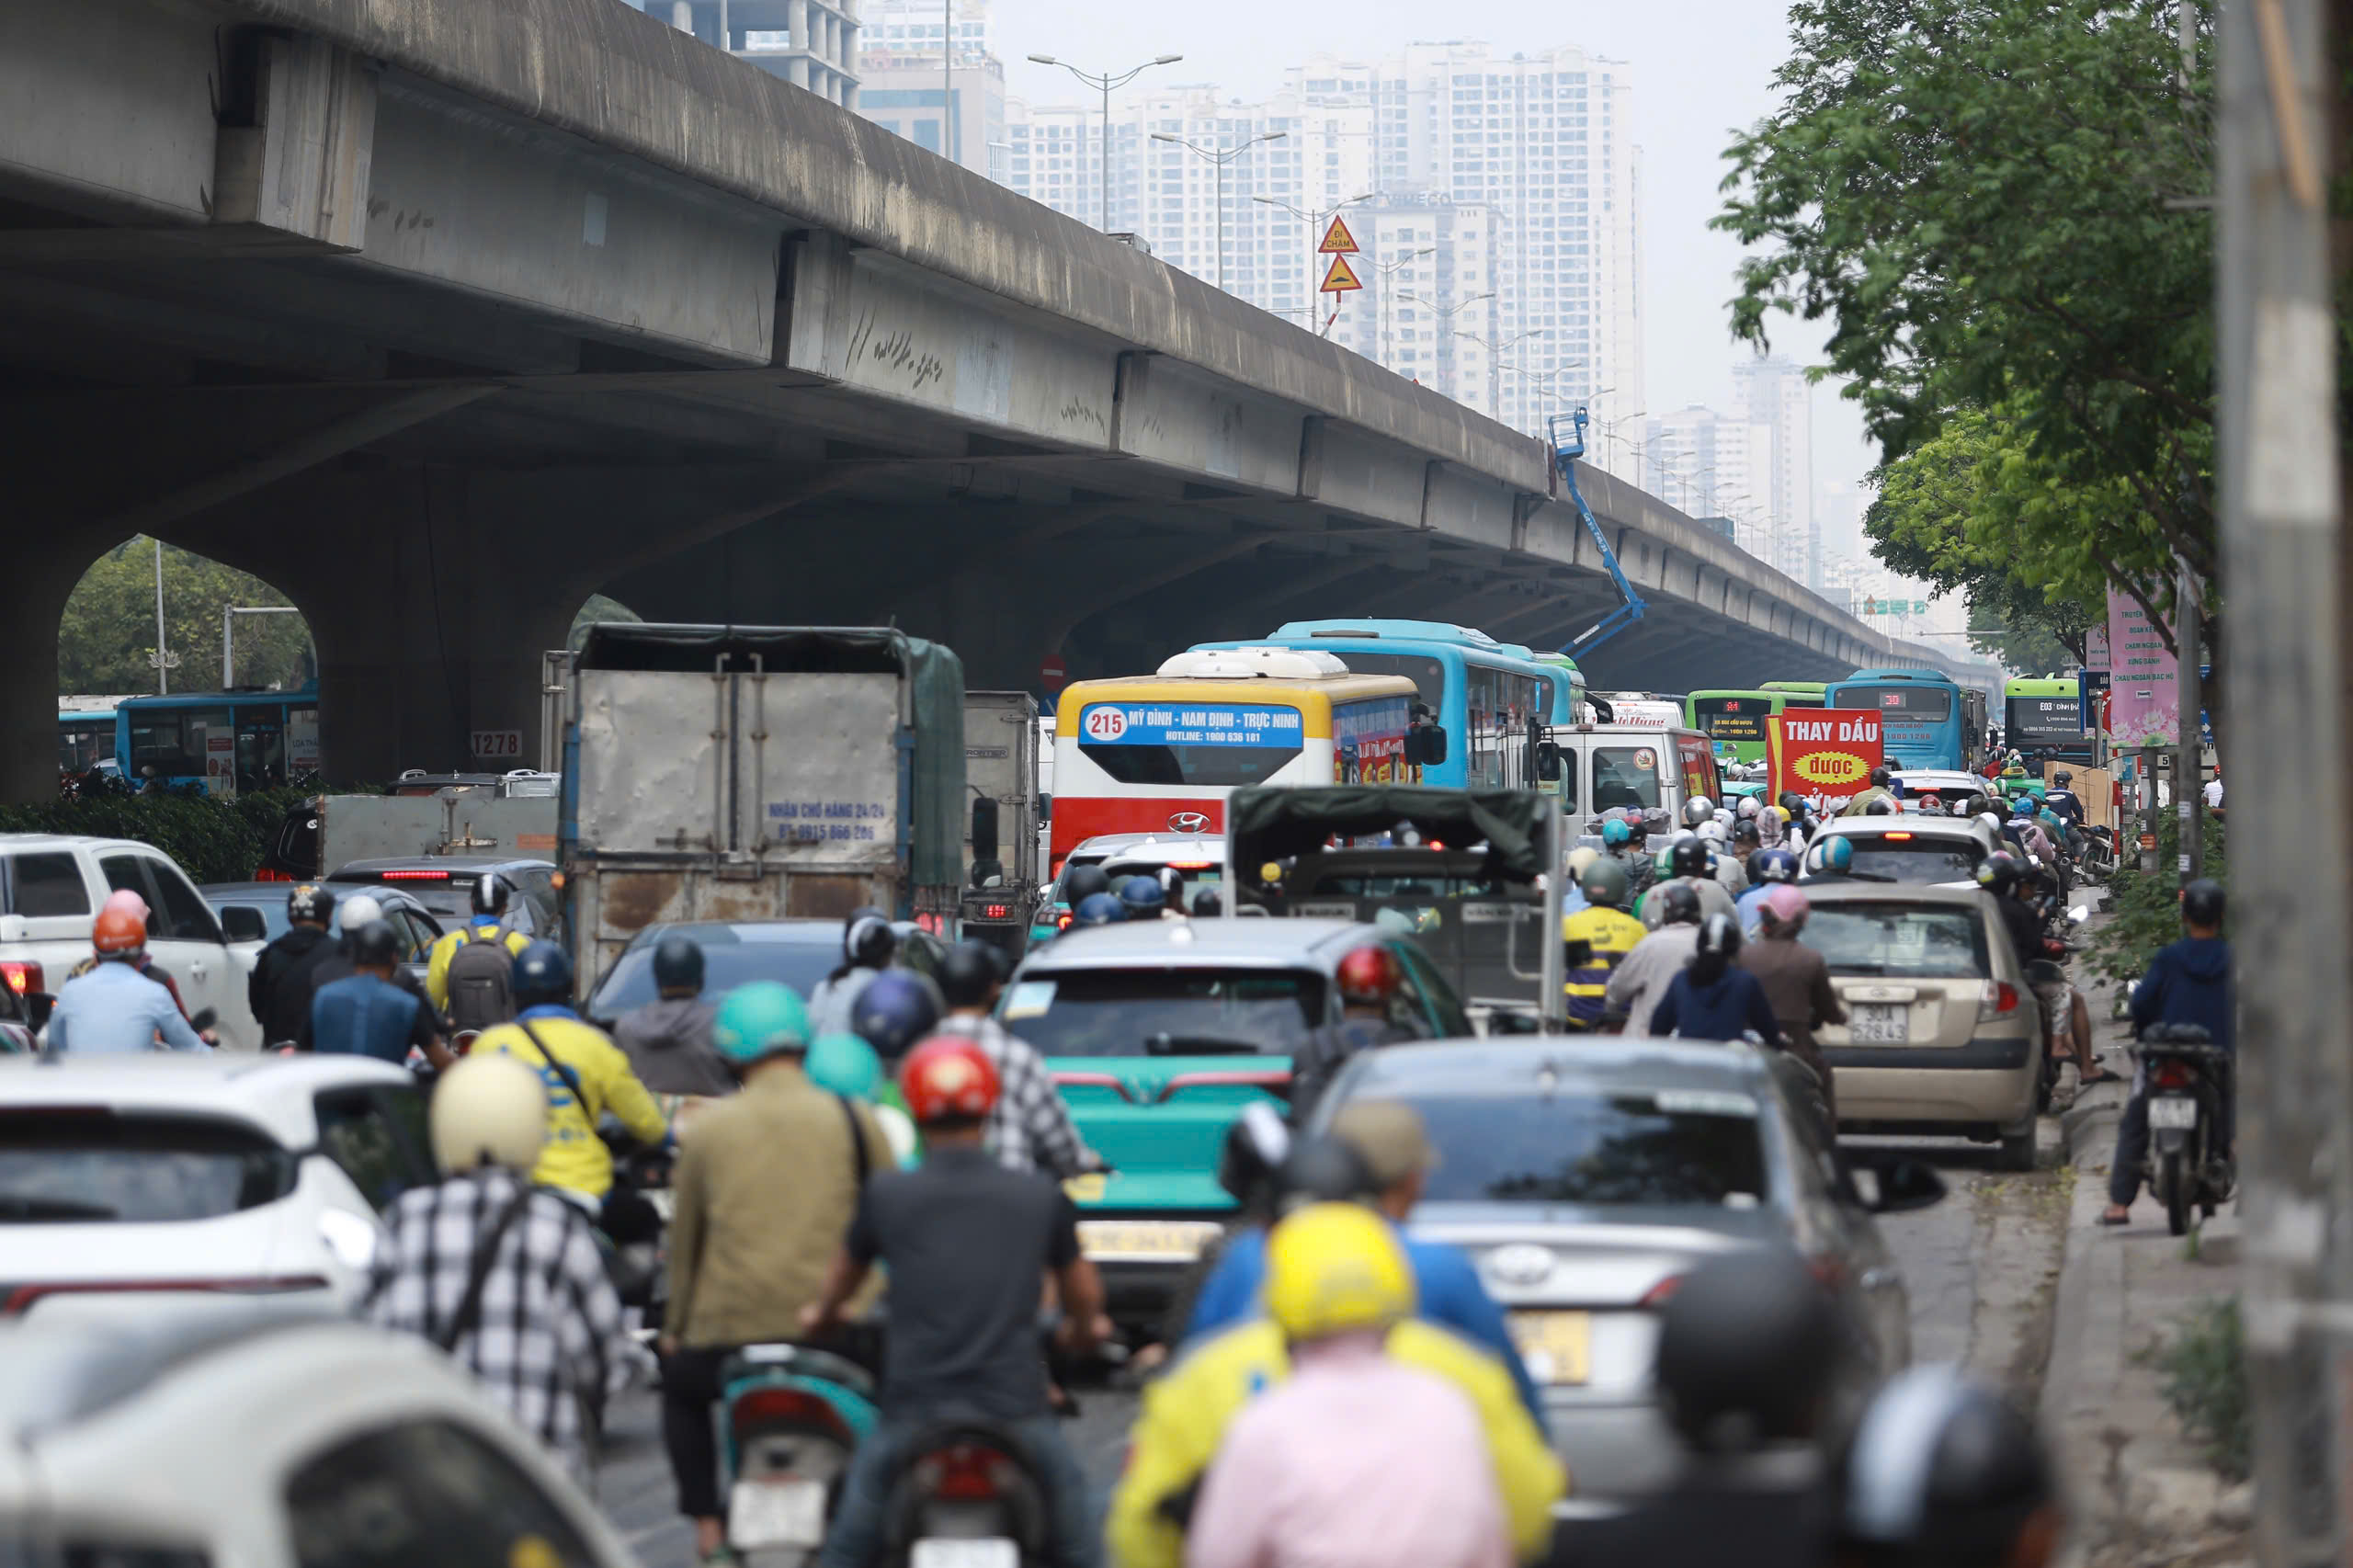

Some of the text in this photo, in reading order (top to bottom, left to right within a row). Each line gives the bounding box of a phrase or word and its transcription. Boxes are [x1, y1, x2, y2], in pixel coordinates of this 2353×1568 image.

[2040, 701, 2052, 711] E03
[1091, 713, 1122, 733] 215
[1129, 708, 1299, 732] MỸ ĐÌNH NAM ĐỊNH TRỰC NINH
[1165, 731, 1203, 742] HOTLINE:
[1245, 733, 1261, 743] 181
[1786, 716, 1878, 743] THAY DẦU
[965, 749, 1008, 758] RONTIER
[2162, 756, 2168, 766] 5
[1809, 756, 1853, 778] được
